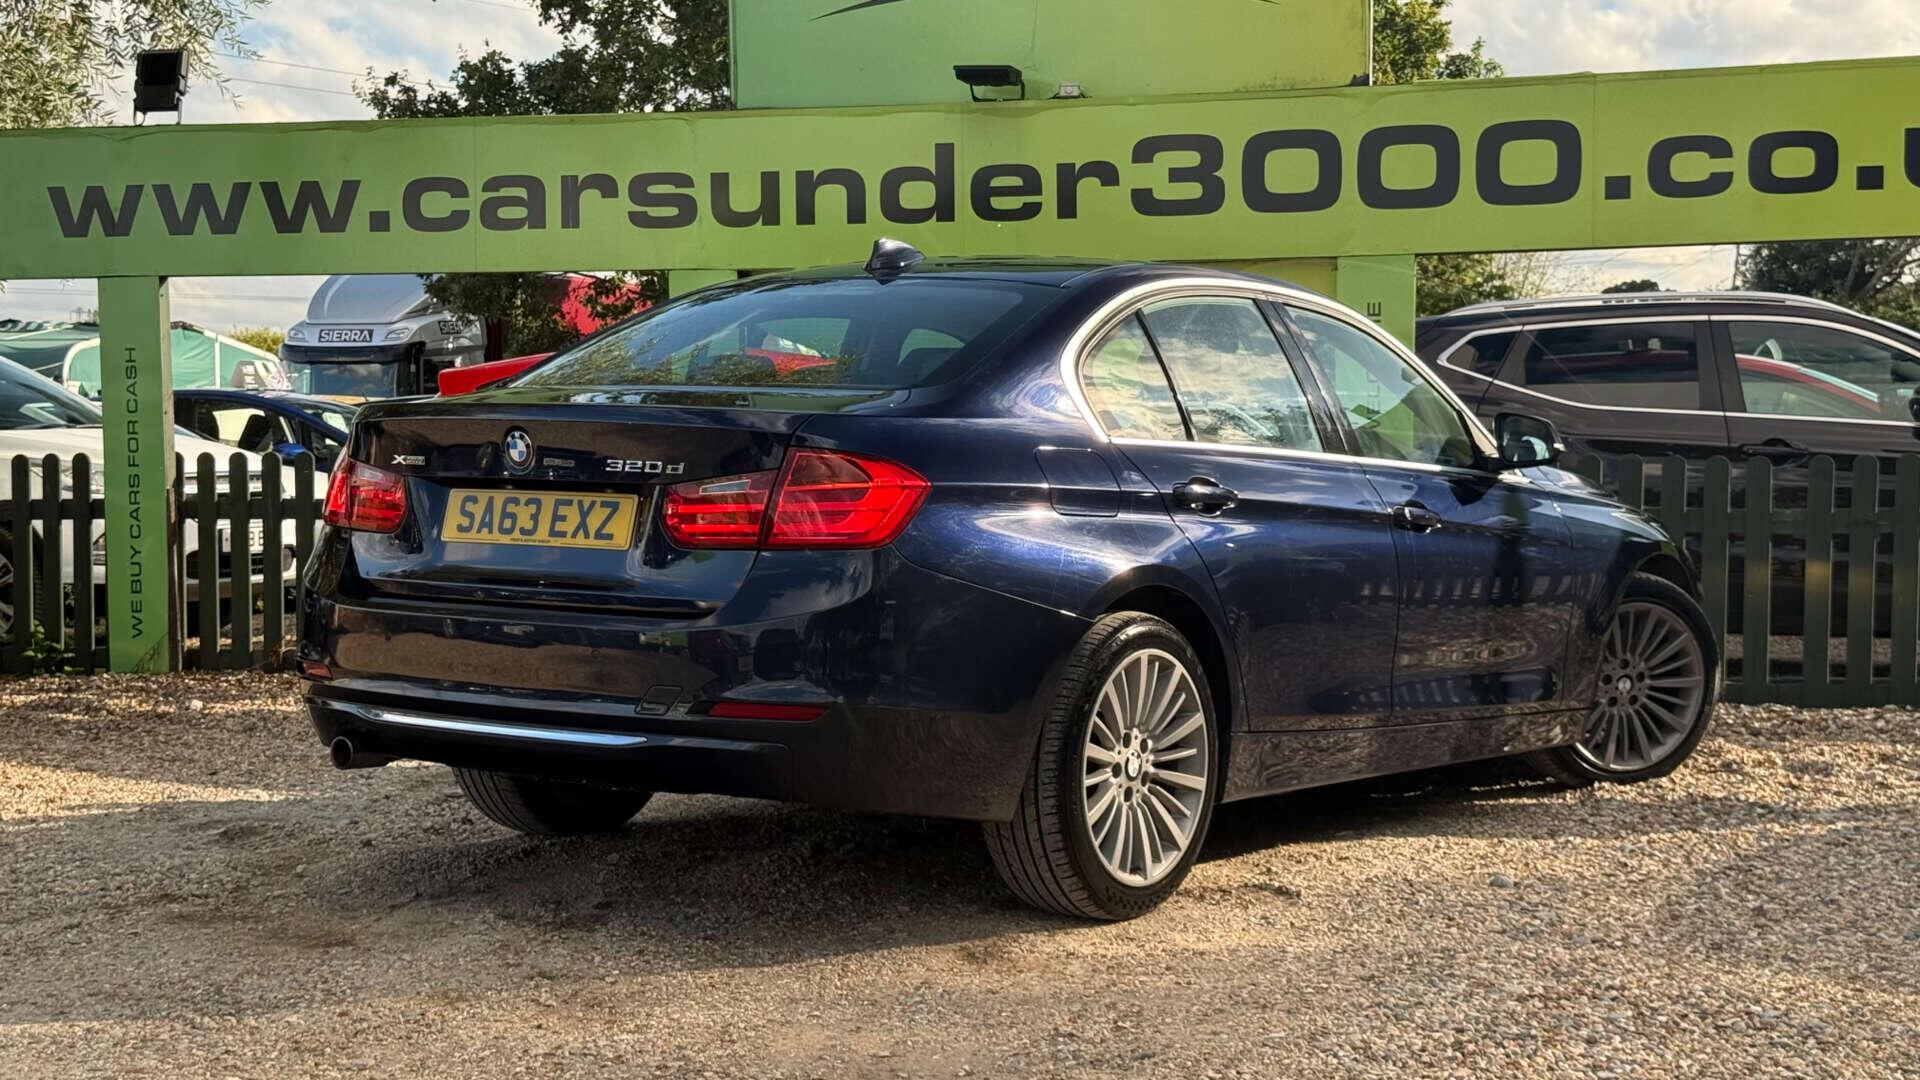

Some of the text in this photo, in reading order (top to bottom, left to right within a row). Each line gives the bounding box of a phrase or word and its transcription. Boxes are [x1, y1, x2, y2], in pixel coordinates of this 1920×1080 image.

[46, 119, 1920, 238] www.carsunder3000.co.
[319, 329, 371, 342] SIERRA
[605, 459, 685, 474] 320d
[125, 347, 144, 639] WE BUY CARS FOR CASH
[456, 495, 621, 541] SA63 EXZ
